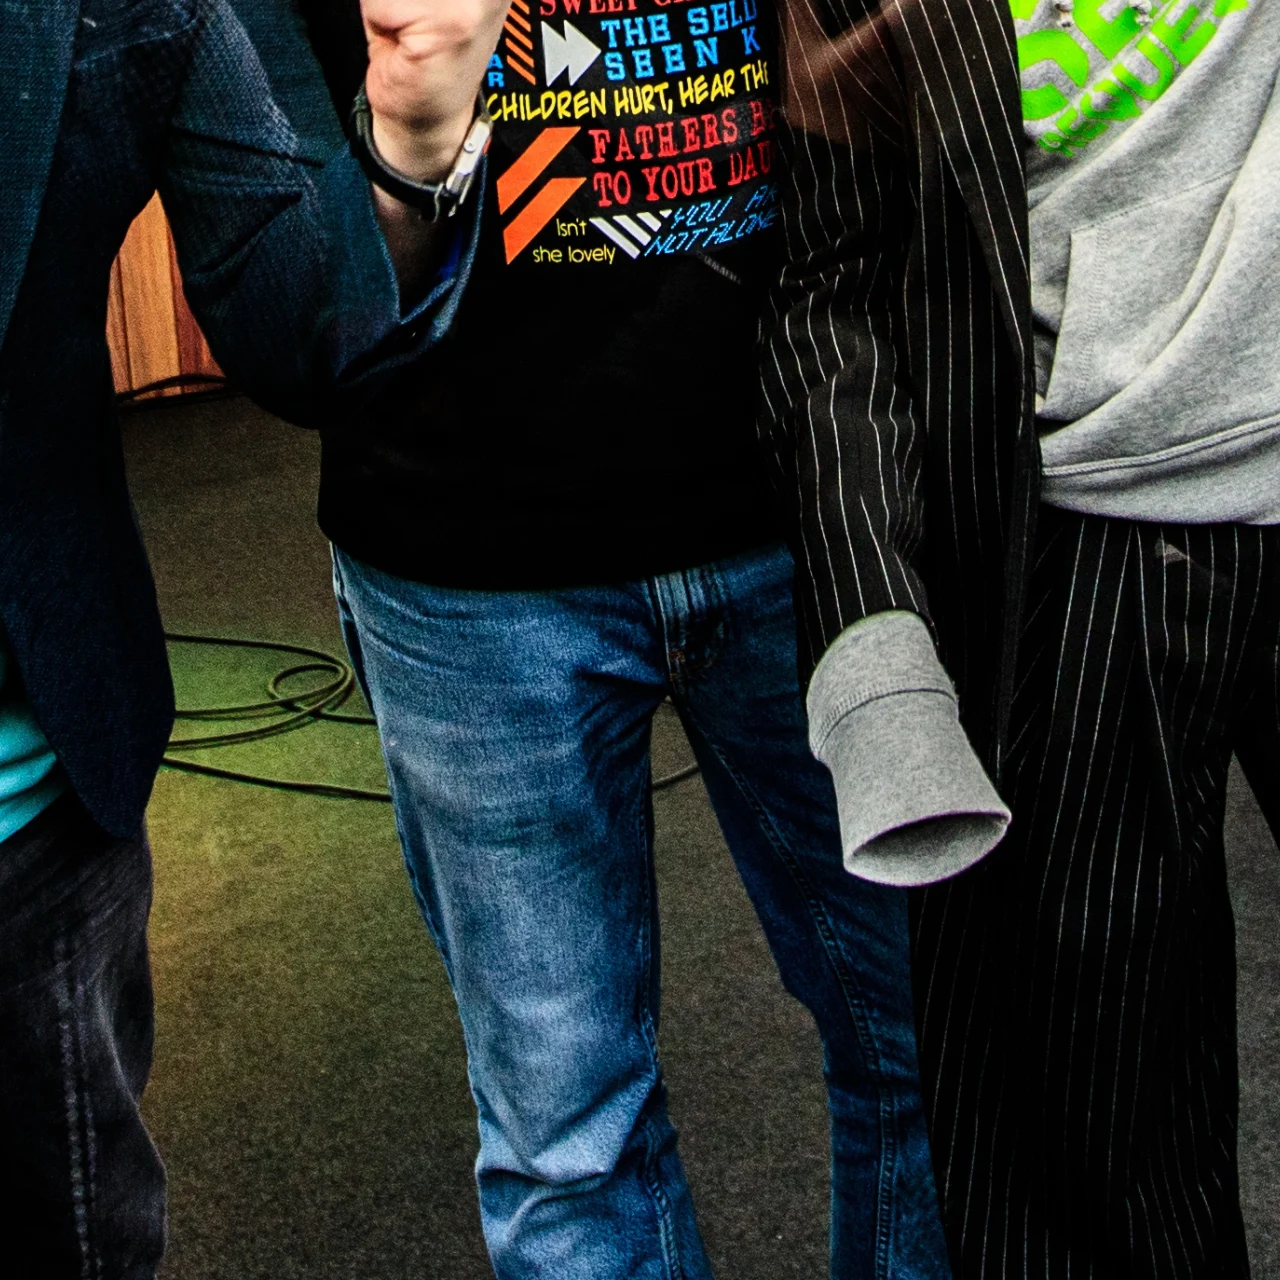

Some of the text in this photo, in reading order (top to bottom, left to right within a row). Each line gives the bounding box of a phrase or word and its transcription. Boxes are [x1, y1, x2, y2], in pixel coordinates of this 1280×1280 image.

[601, 13, 671, 48] THE
[604, 37, 719, 81] SEEN
[486, 88, 607, 122] CHILDREN
[614, 82, 673, 115] HURT,
[679, 68, 736, 109] HEAR
[588, 107, 739, 165] FATHERS
[593, 172, 631, 207] TO
[642, 157, 717, 201] YOUR
[557, 219, 587, 236] Isn't
[532, 245, 616, 264] she lovely
